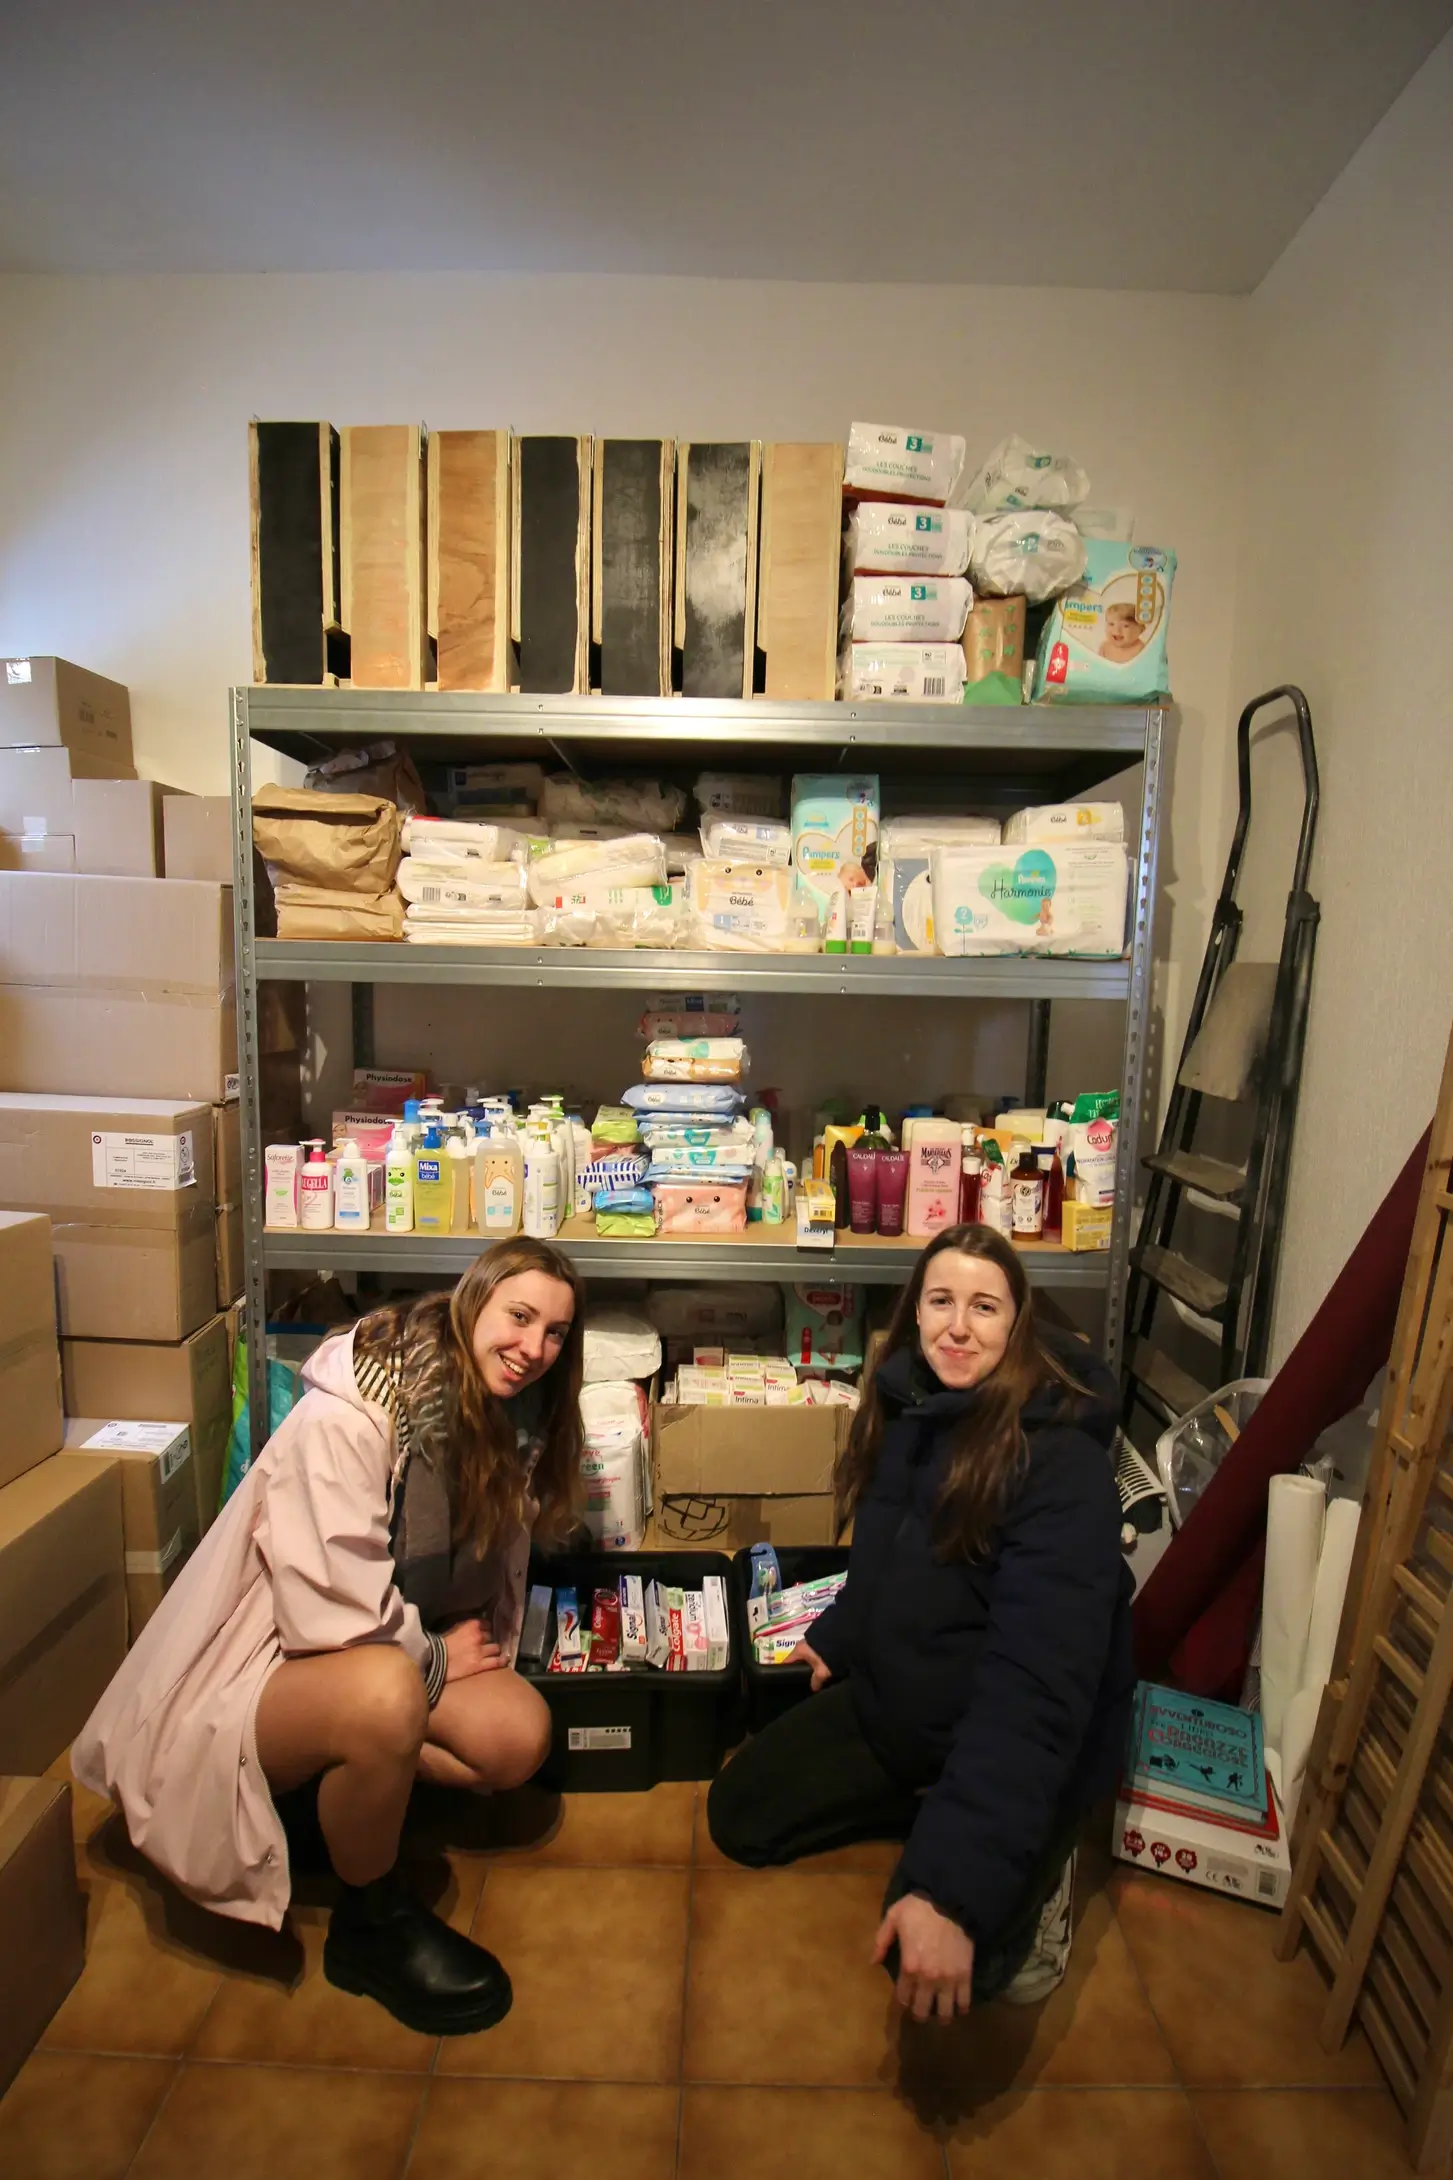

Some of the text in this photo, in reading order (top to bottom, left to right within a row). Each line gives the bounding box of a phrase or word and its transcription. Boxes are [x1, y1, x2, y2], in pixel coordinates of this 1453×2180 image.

[909, 438, 918, 450] 3
[919, 517, 928, 529] 3
[914, 587, 922, 599] 3
[802, 846, 841, 860] Pampers
[990, 876, 1053, 900] Harmonie
[729, 895, 754, 906] Bébé
[366, 1073, 413, 1083] Physiodose
[419, 1162, 438, 1171] Mixa
[735, 1395, 759, 1405] Intima
[582, 1462, 604, 1471] reen
[686, 1593, 698, 1621] zendium
[626, 1612, 639, 1640] Signal
[672, 1612, 682, 1653] Colgate
[776, 1638, 796, 1649] Sign
